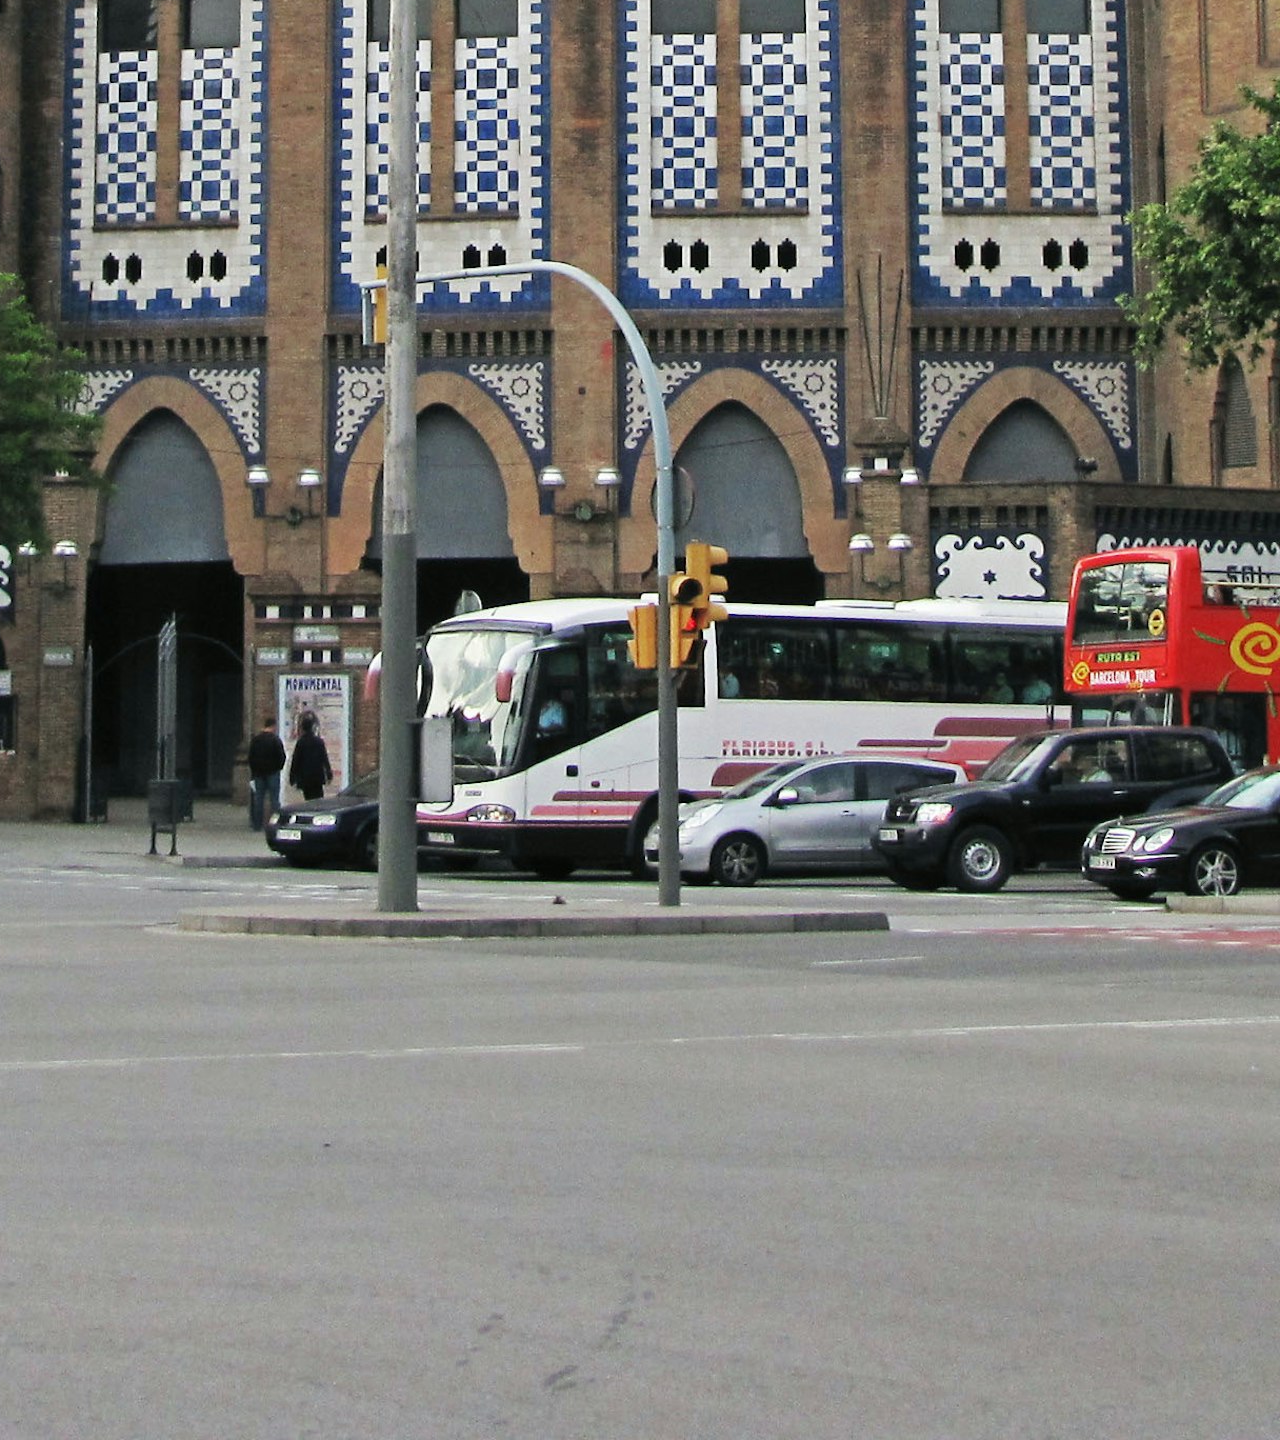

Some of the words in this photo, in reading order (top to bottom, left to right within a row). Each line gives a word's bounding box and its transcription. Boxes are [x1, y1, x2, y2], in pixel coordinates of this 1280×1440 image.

[1090, 670, 1131, 685] BARCELONA
[1135, 668, 1156, 682] TOUR
[286, 678, 342, 690] MONUMENTAL
